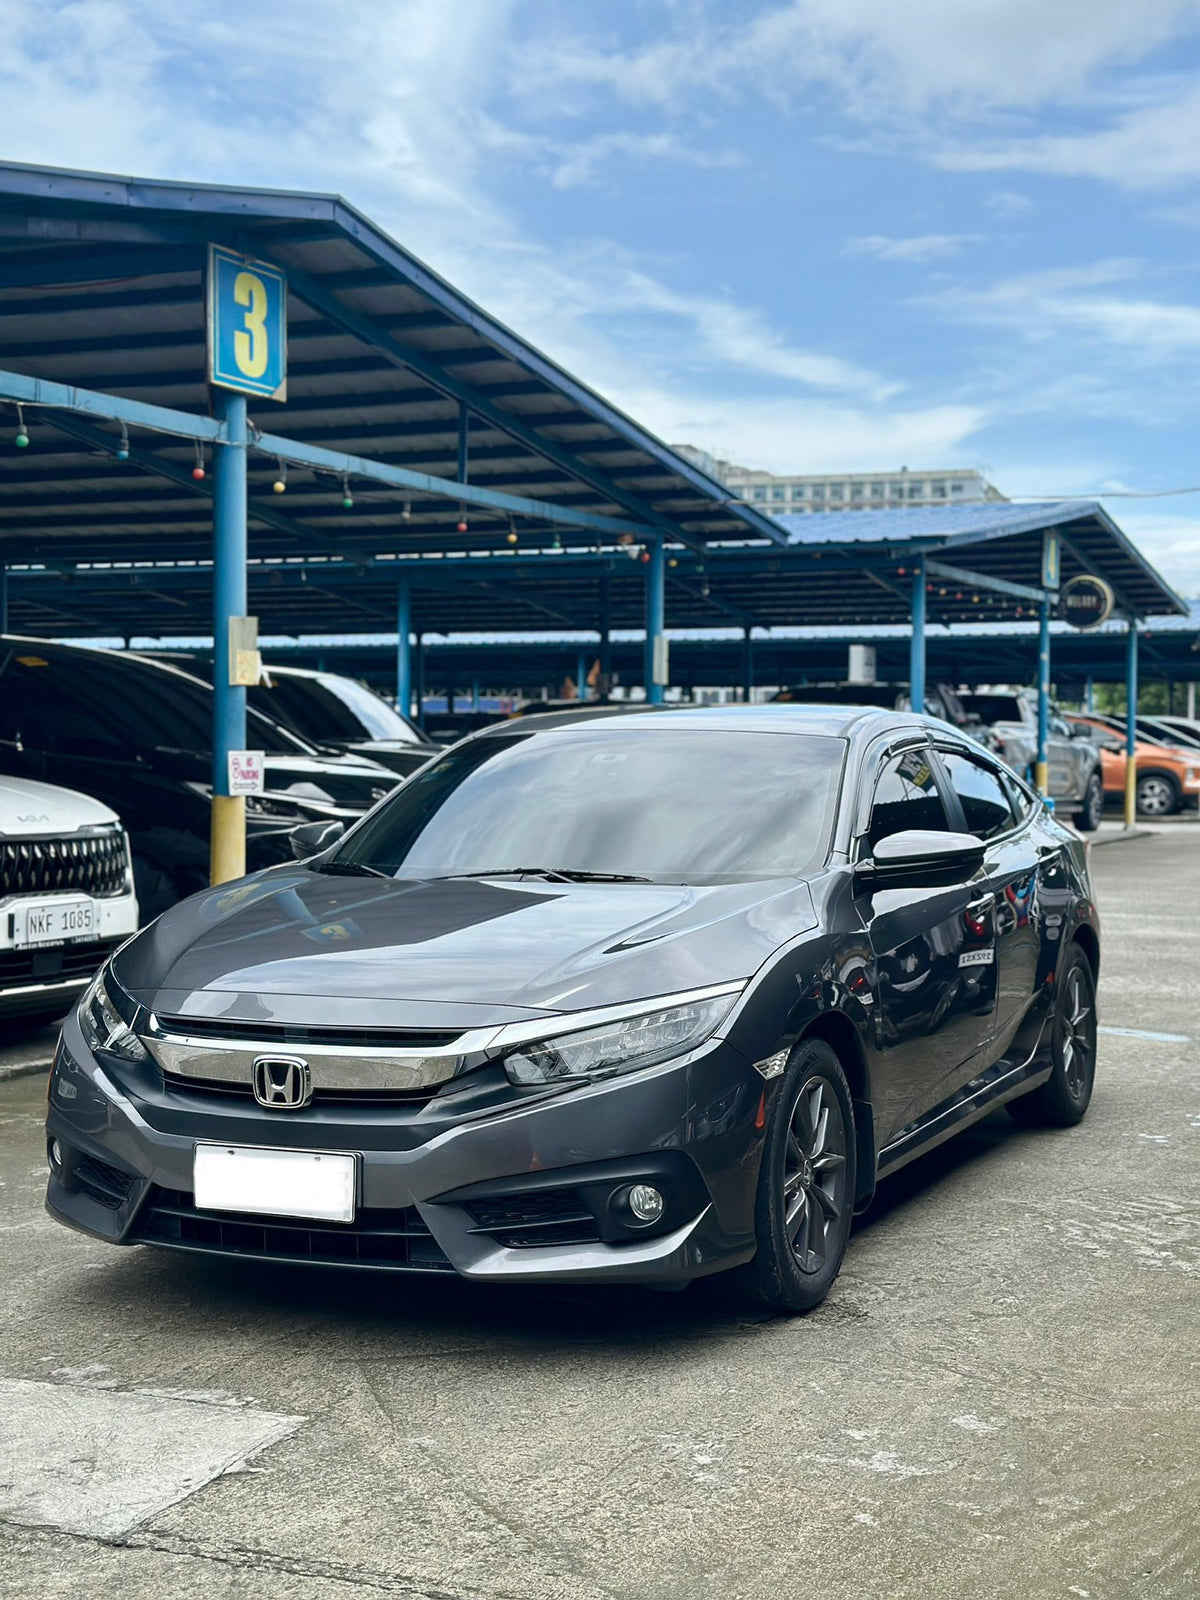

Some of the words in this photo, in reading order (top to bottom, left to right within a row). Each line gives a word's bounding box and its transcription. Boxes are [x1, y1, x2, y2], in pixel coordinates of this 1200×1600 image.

[234, 272, 268, 378] 3
[29, 913, 53, 935] NKF
[61, 909, 91, 931] 1085
